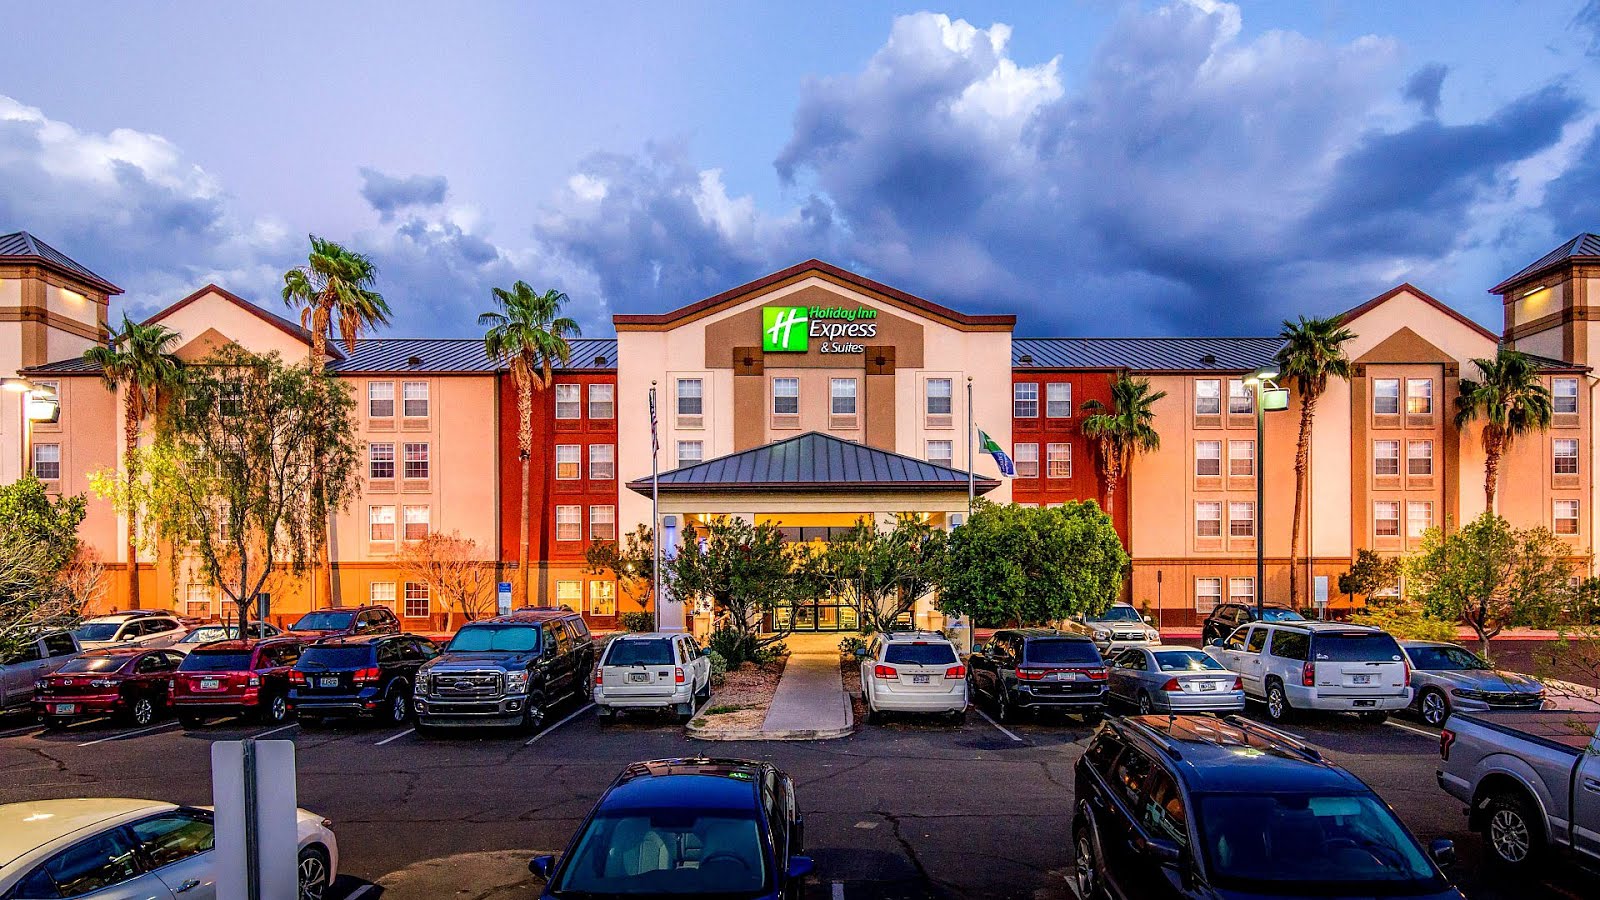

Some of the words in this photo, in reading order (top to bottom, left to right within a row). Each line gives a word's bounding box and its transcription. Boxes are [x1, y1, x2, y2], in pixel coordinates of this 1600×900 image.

[809, 305, 857, 321] Holiday
[857, 306, 877, 319] Inn
[809, 320, 877, 341] Express
[820, 341, 830, 353] &
[830, 341, 864, 353] Suites
